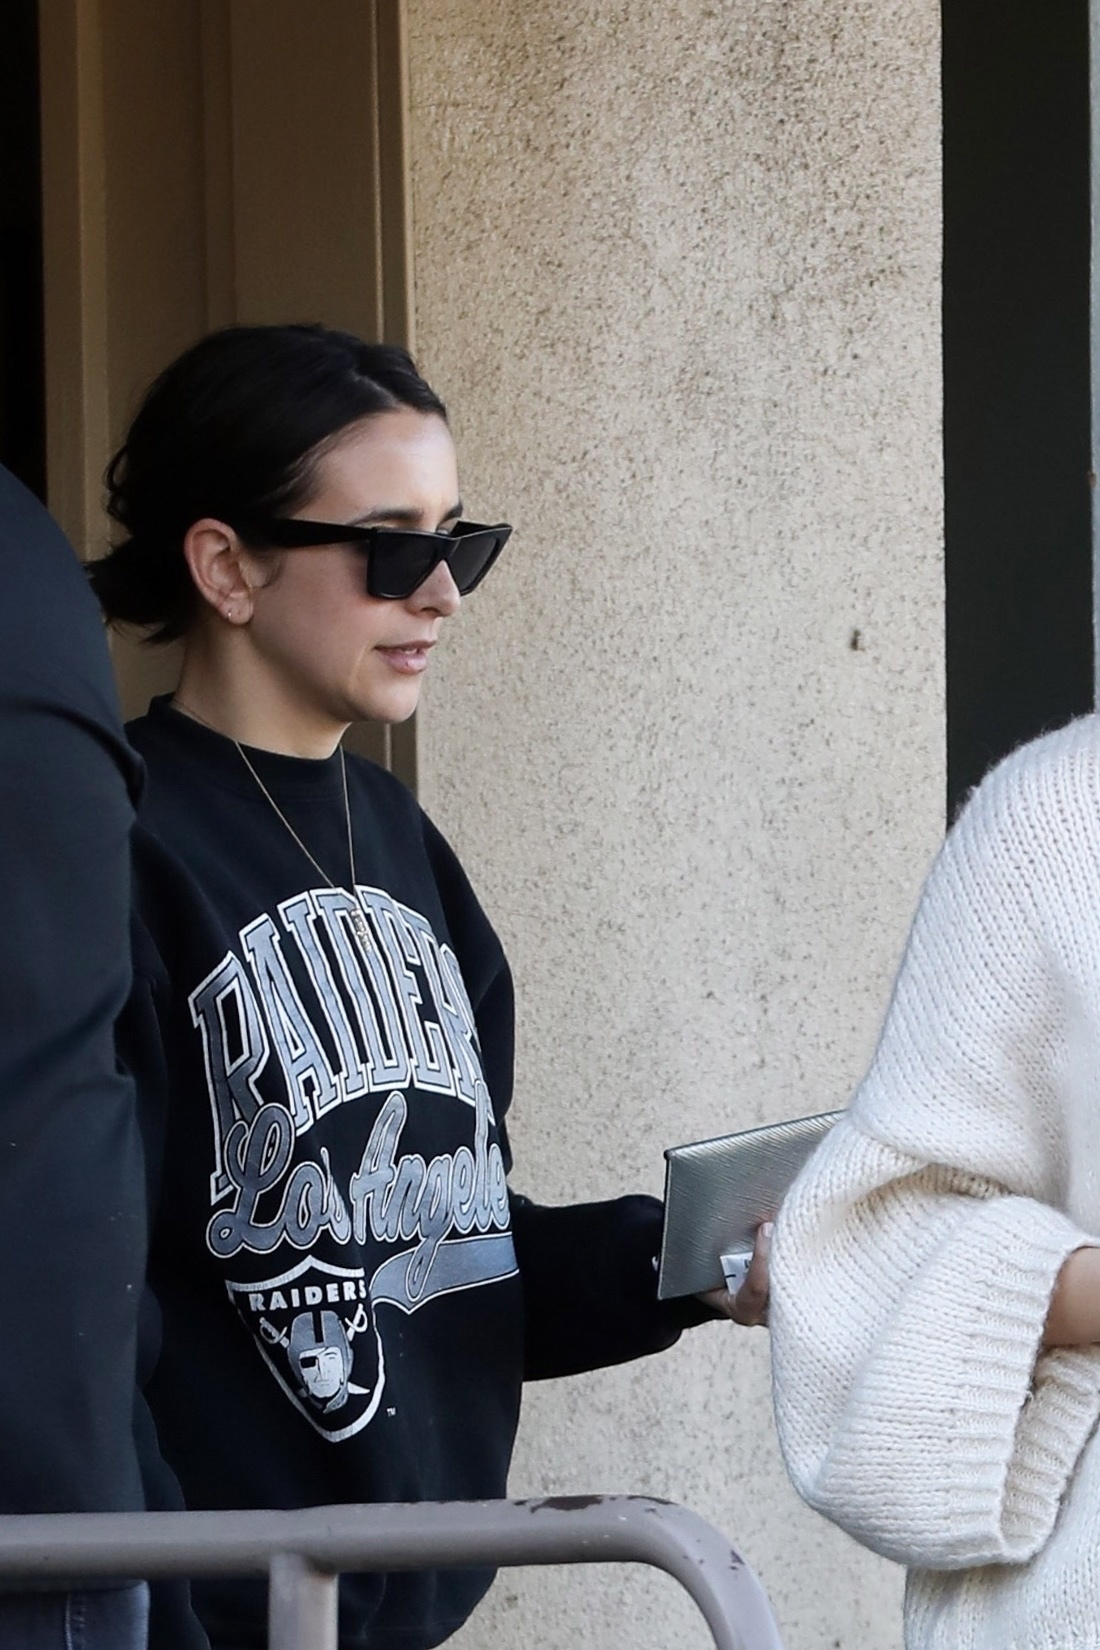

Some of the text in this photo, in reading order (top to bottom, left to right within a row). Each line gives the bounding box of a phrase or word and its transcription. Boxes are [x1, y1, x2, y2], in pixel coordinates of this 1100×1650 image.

[188, 885, 497, 1207] RAIDER
[206, 1102, 350, 1258] Los
[248, 1279, 367, 1311] RAIDERS
